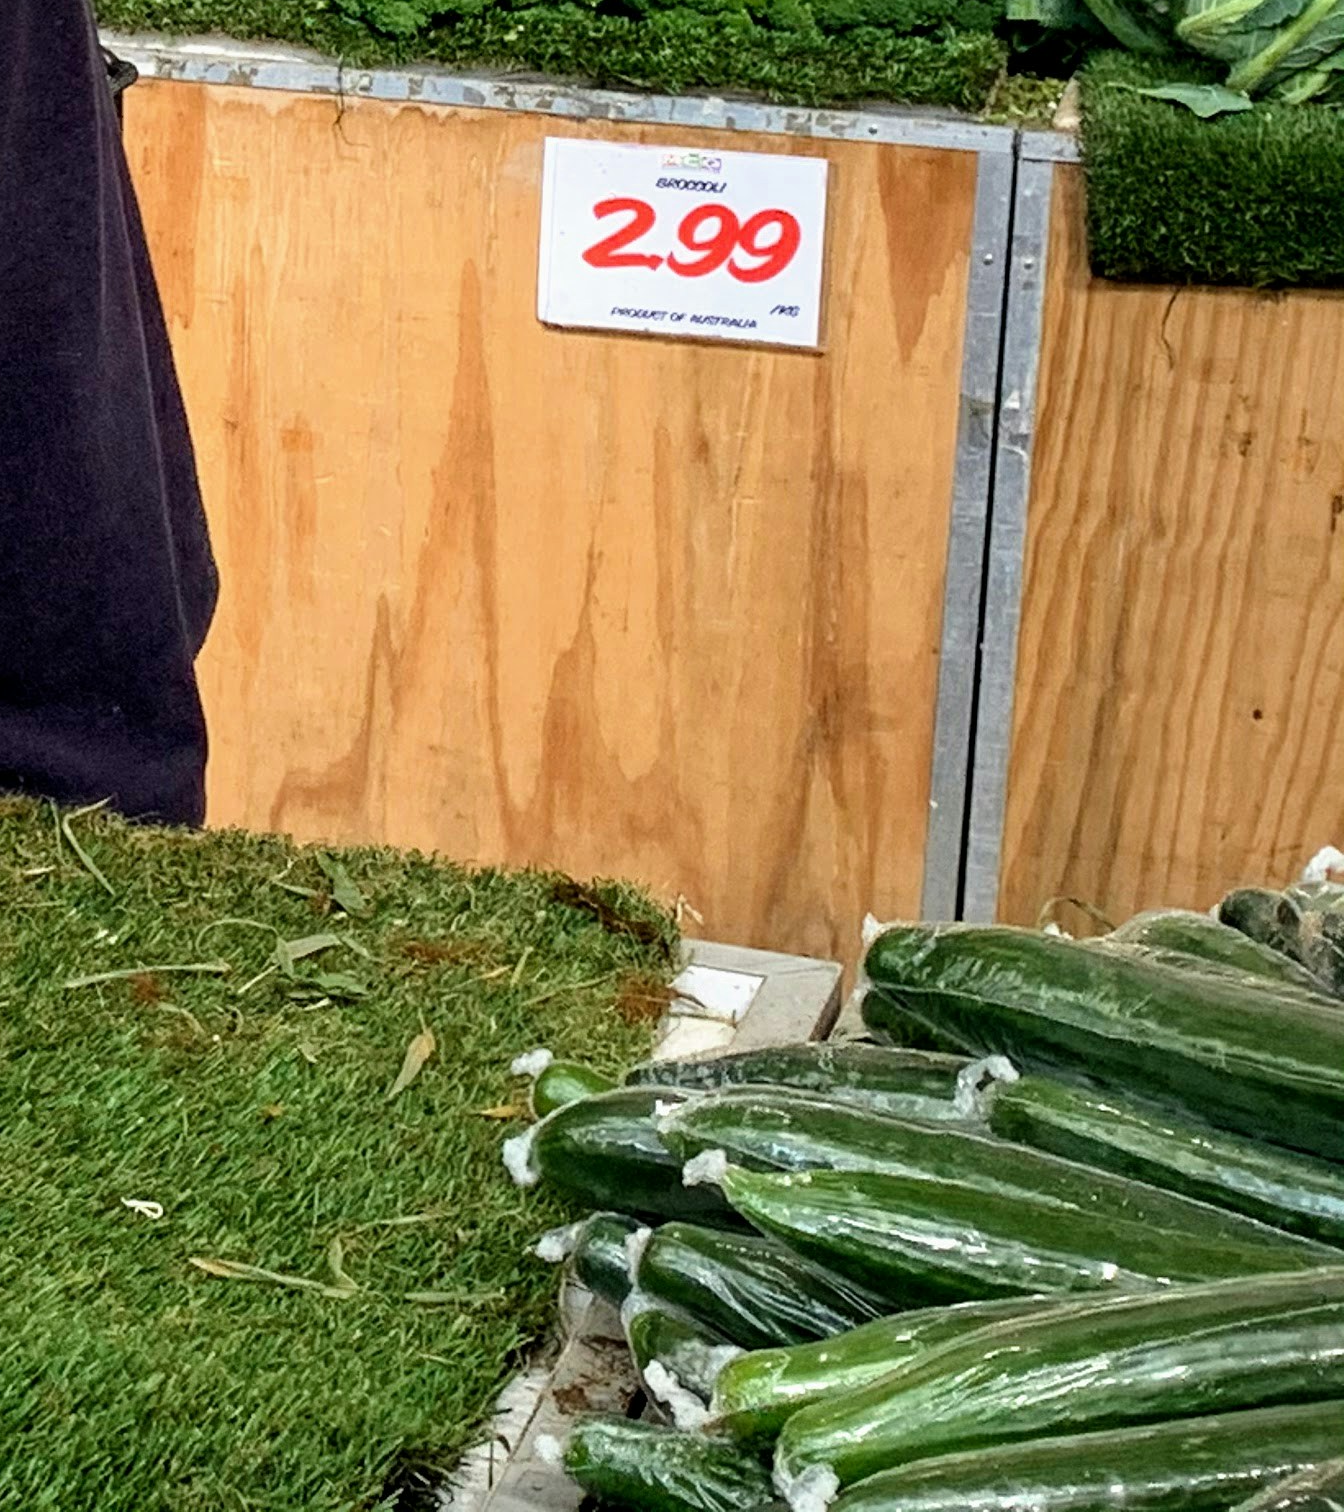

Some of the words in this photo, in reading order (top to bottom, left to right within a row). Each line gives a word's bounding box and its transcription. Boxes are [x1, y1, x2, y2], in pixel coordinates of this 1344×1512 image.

[655, 178, 727, 193] BROCCOLI
[582, 197, 801, 283] 2.99
[610, 306, 667, 322] PRODUCT
[669, 311, 686, 323] OF
[689, 314, 758, 330] AUSTRALIA
